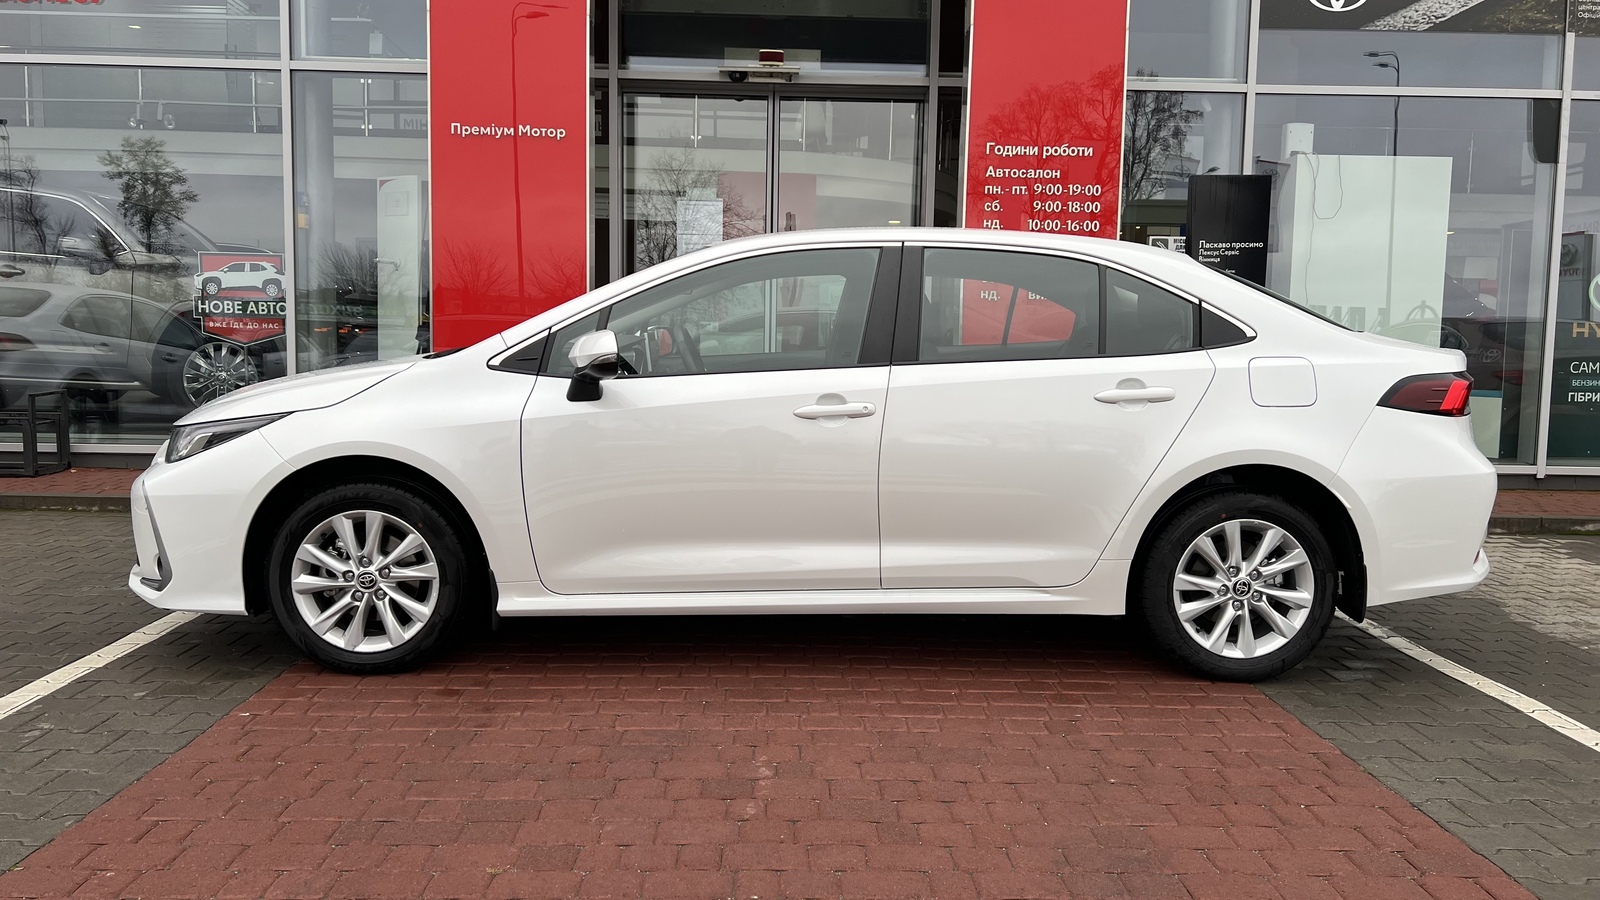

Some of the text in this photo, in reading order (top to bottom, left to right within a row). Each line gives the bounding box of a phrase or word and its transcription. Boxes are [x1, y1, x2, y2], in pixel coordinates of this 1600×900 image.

[450, 122, 566, 141] Преміум Мотор
[985, 142, 1094, 159] Години роботи
[985, 165, 1061, 179] Автосалон
[984, 200, 1004, 212] сб.
[983, 219, 1004, 231] нд.
[1198, 240, 1264, 250] Ласкаво просимо
[980, 290, 1001, 301] нд.
[198, 300, 243, 314] НОВЕ
[246, 301, 287, 315] АВТО
